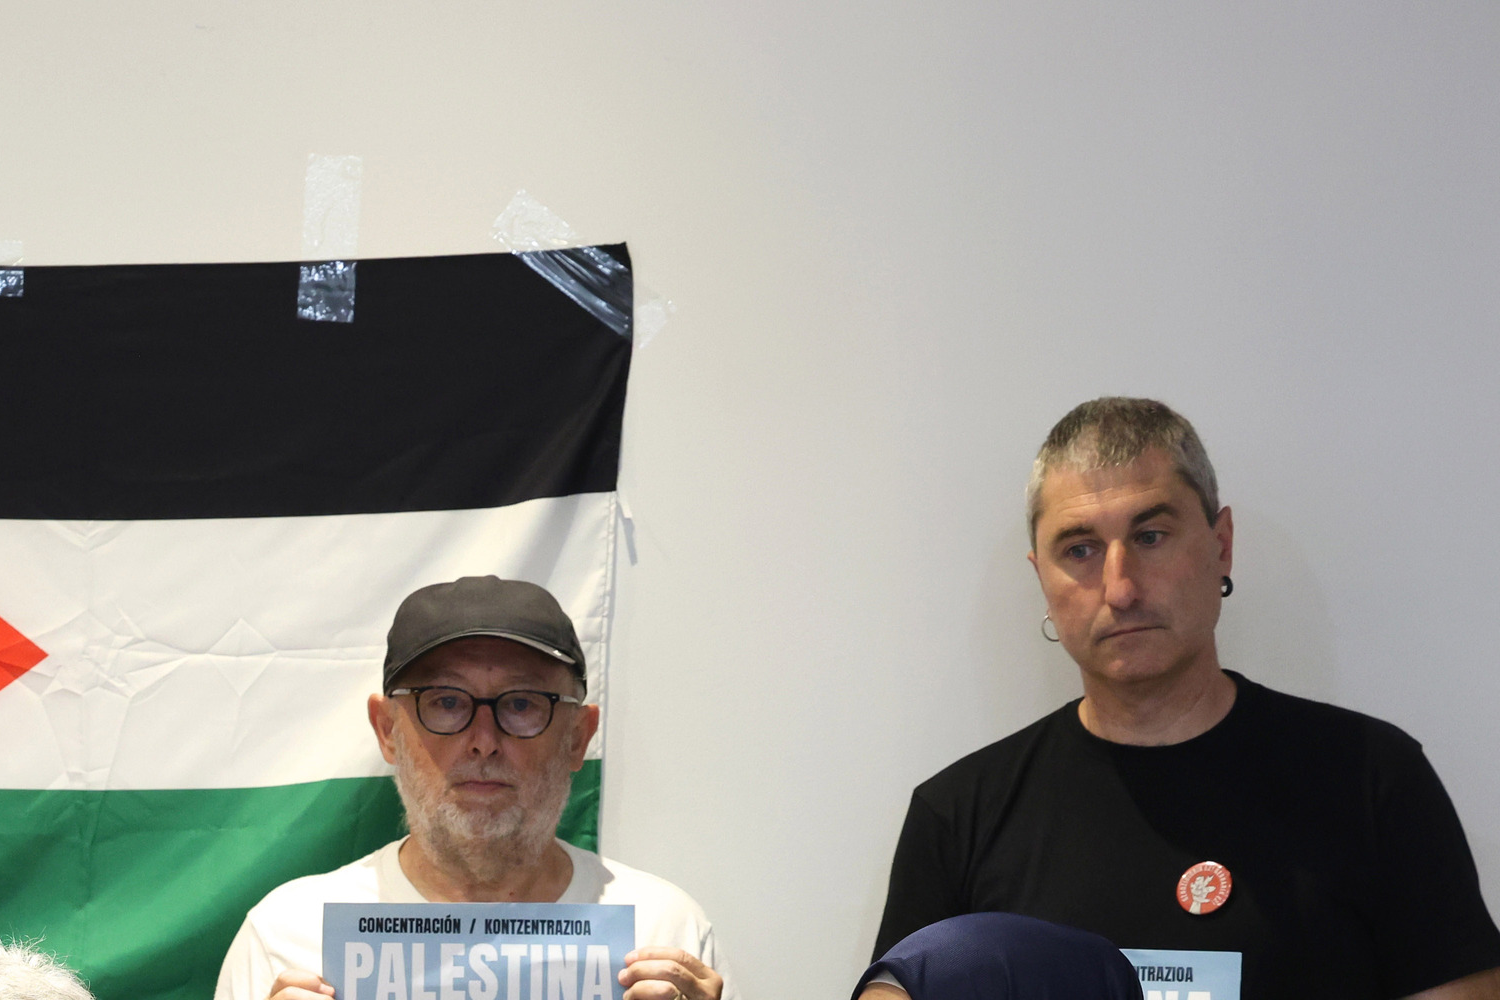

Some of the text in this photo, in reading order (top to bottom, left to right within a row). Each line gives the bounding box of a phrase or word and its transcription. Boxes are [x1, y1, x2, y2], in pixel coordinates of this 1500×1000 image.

[359, 915, 591, 935] CONCENTRACIÓN / KONTZENTRAZIOA
